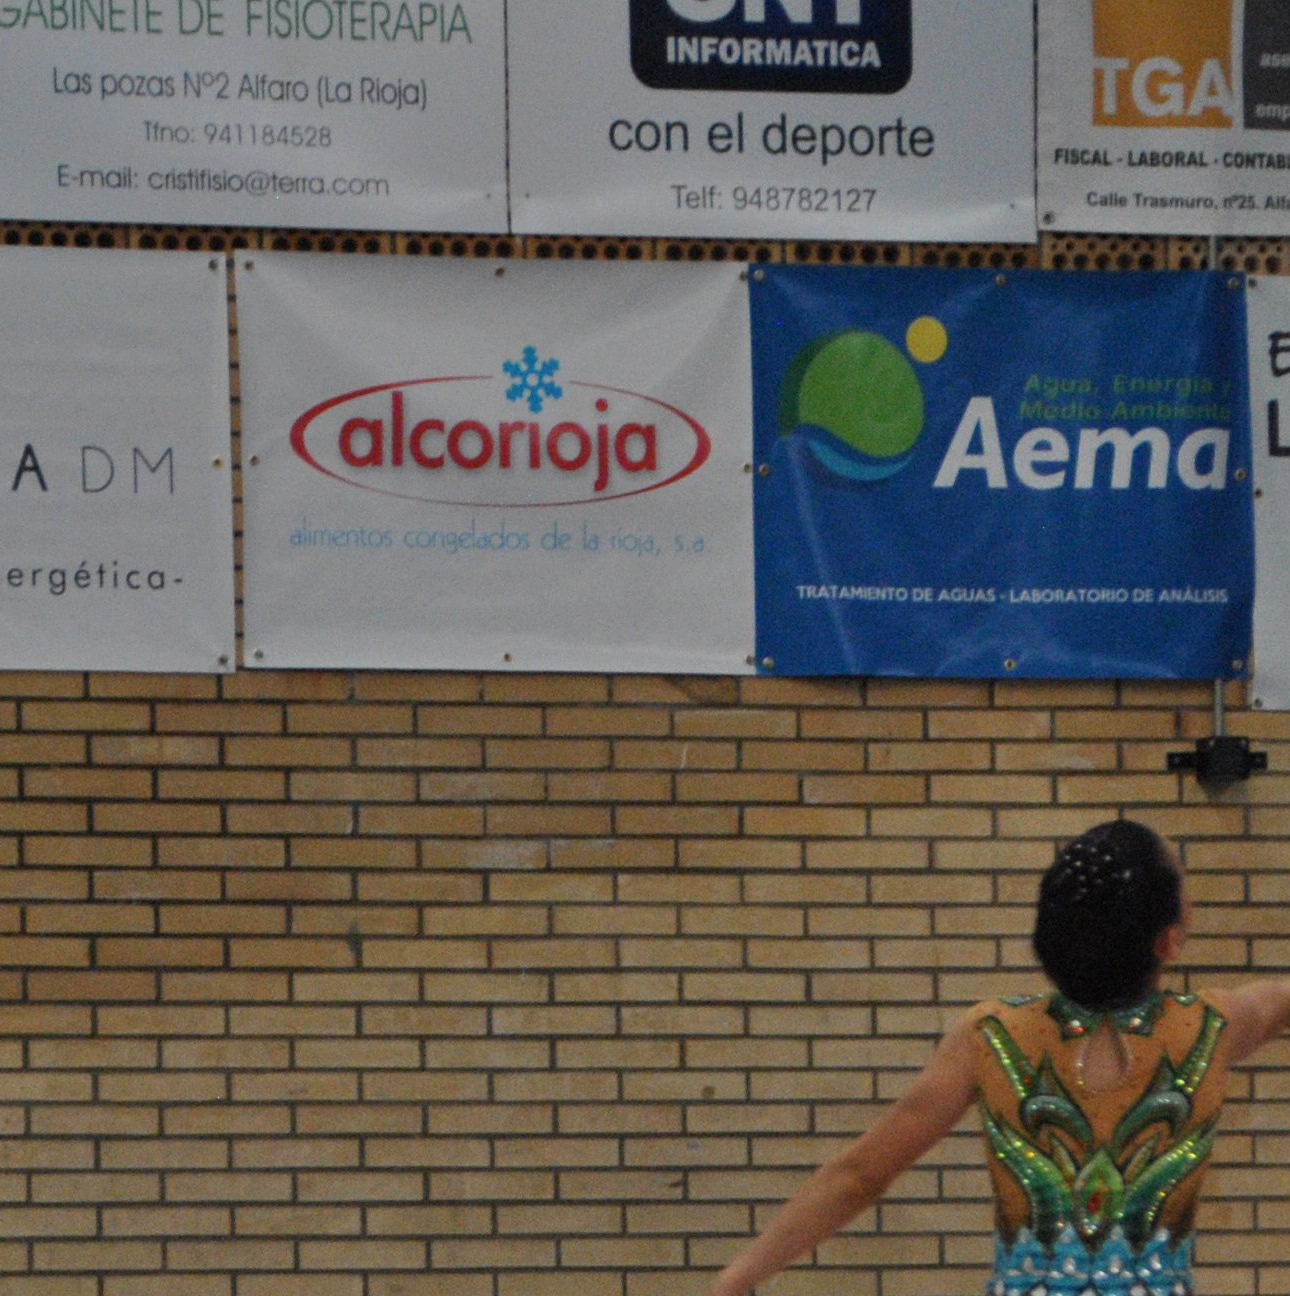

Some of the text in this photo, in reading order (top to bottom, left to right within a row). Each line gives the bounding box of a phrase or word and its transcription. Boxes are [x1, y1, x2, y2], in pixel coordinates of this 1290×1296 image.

[177, 0, 225, 37] DE
[245, 0, 472, 45] FISIOTERAPIA
[666, 36, 883, 69] INFORMATICA
[52, 67, 93, 97] Las
[99, 74, 176, 101] pozas
[237, 74, 310, 102] Alfaro
[316, 76, 353, 110] (La
[359, 78, 428, 111] Rioja)
[1093, 57, 1233, 118] TGA
[143, 120, 333, 149] Tfno: 941184528
[608, 111, 937, 166] con el deporte
[1054, 148, 1113, 168] FISCAL
[1127, 150, 1209, 169] LABORAL
[56, 164, 140, 191] E-mail:
[670, 184, 878, 213] Telf: 948782127
[1019, 401, 1103, 420] Medio
[339, 391, 658, 493] alcorioja
[933, 396, 1231, 490] Aema
[81, 445, 175, 496] DM
[290, 517, 394, 549] alimentos
[403, 520, 531, 554] congelados
[540, 521, 573, 552] de
[583, 521, 601, 551] la
[796, 585, 908, 600] TRATAMIENTO
[912, 587, 934, 602] DE
[938, 588, 996, 603] AGUAS
[1010, 589, 1129, 604] LABORATORIO
[1133, 590, 1155, 604] DE
